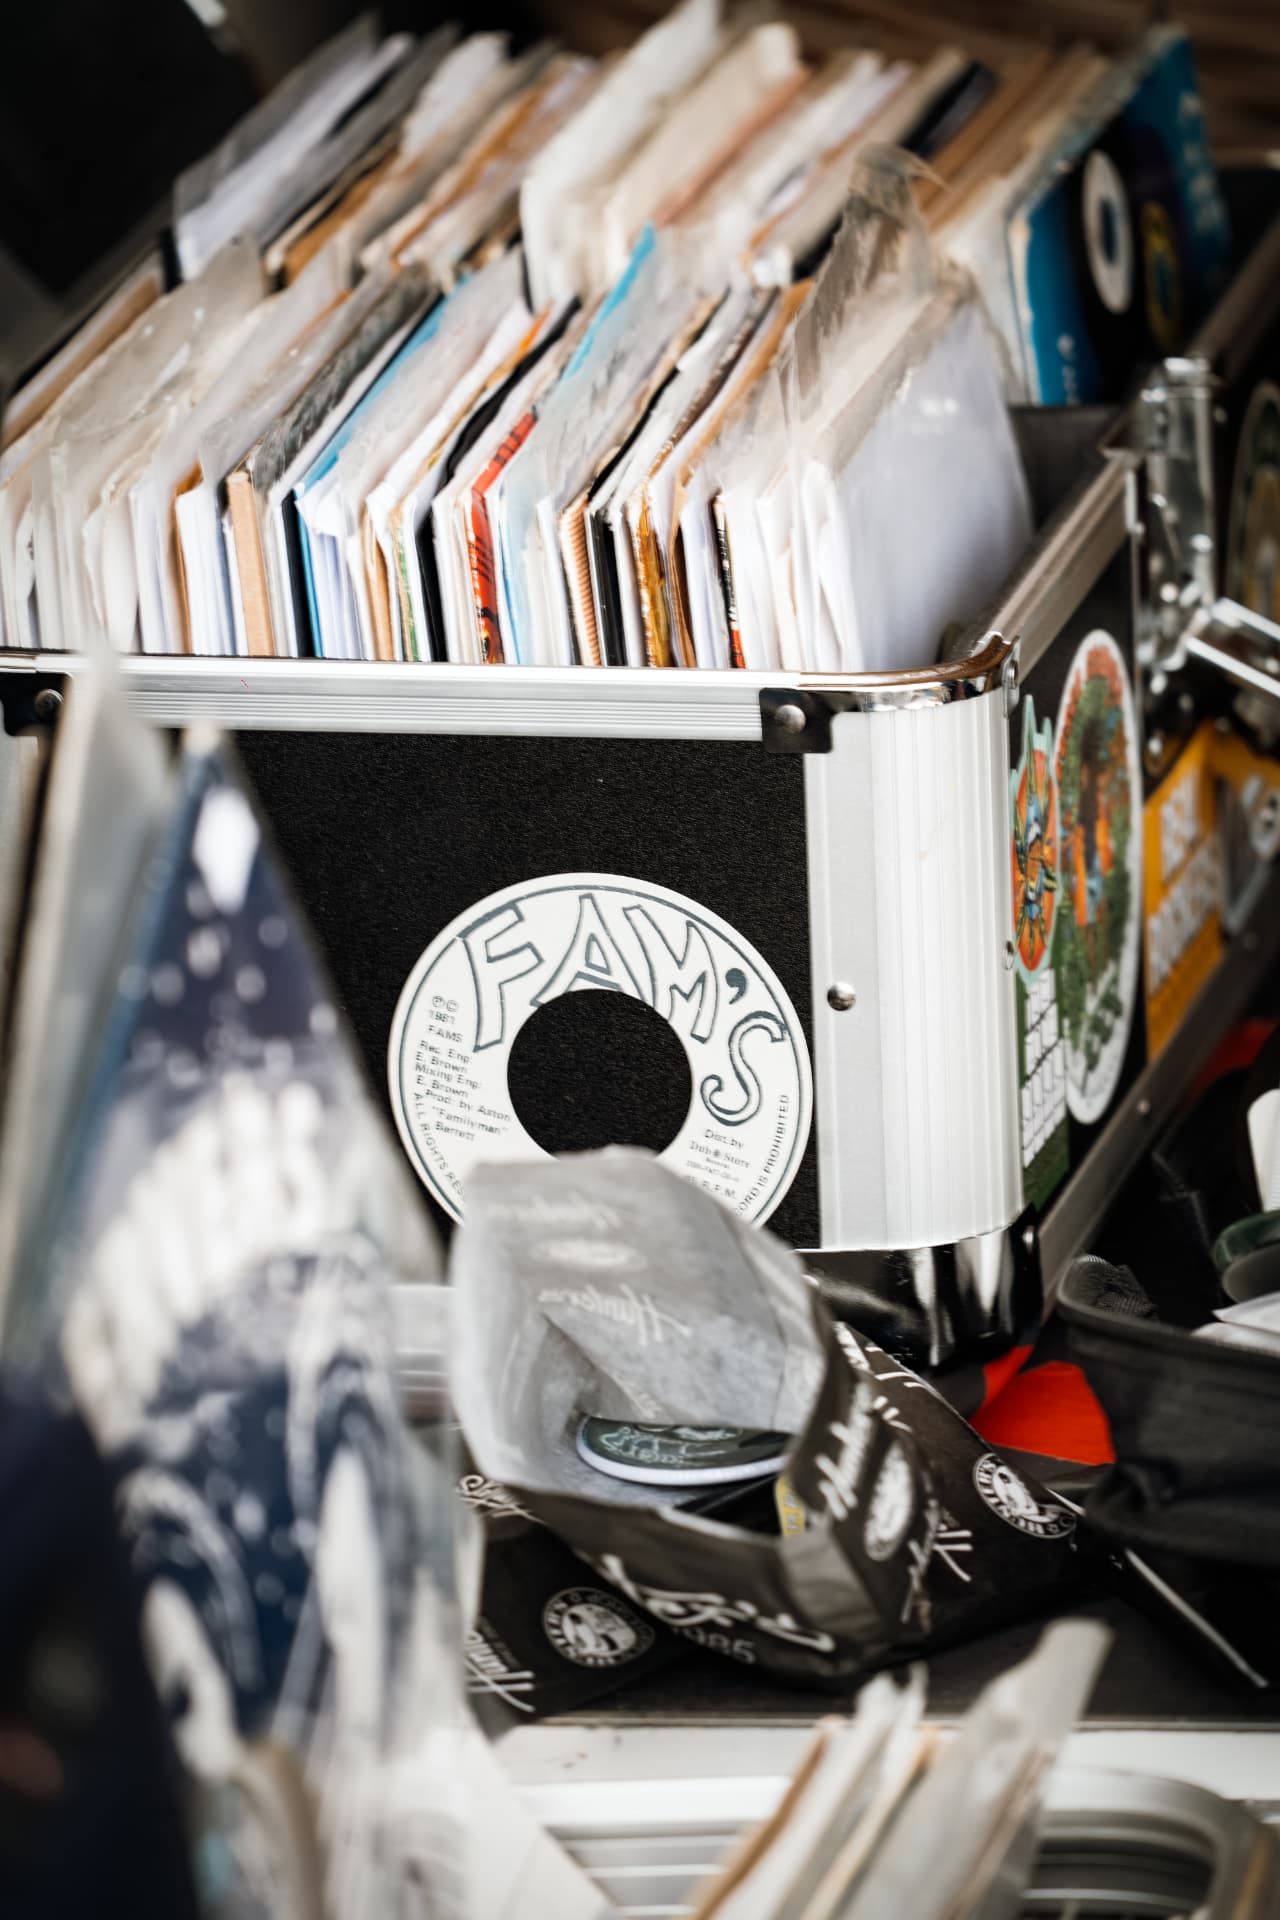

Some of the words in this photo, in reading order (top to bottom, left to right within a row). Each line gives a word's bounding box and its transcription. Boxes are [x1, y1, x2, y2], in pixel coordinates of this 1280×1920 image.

[428, 1025, 464, 1043] FAMS
[415, 1062, 453, 1083] Mixing
[431, 1056, 468, 1074] Brown
[431, 1079, 469, 1098] Brown
[459, 1101, 473, 1111] by
[413, 1092, 425, 1120] ALL
[420, 1123, 448, 1170] RIGHTS
[763, 1094, 790, 1175] PROHIBITED
